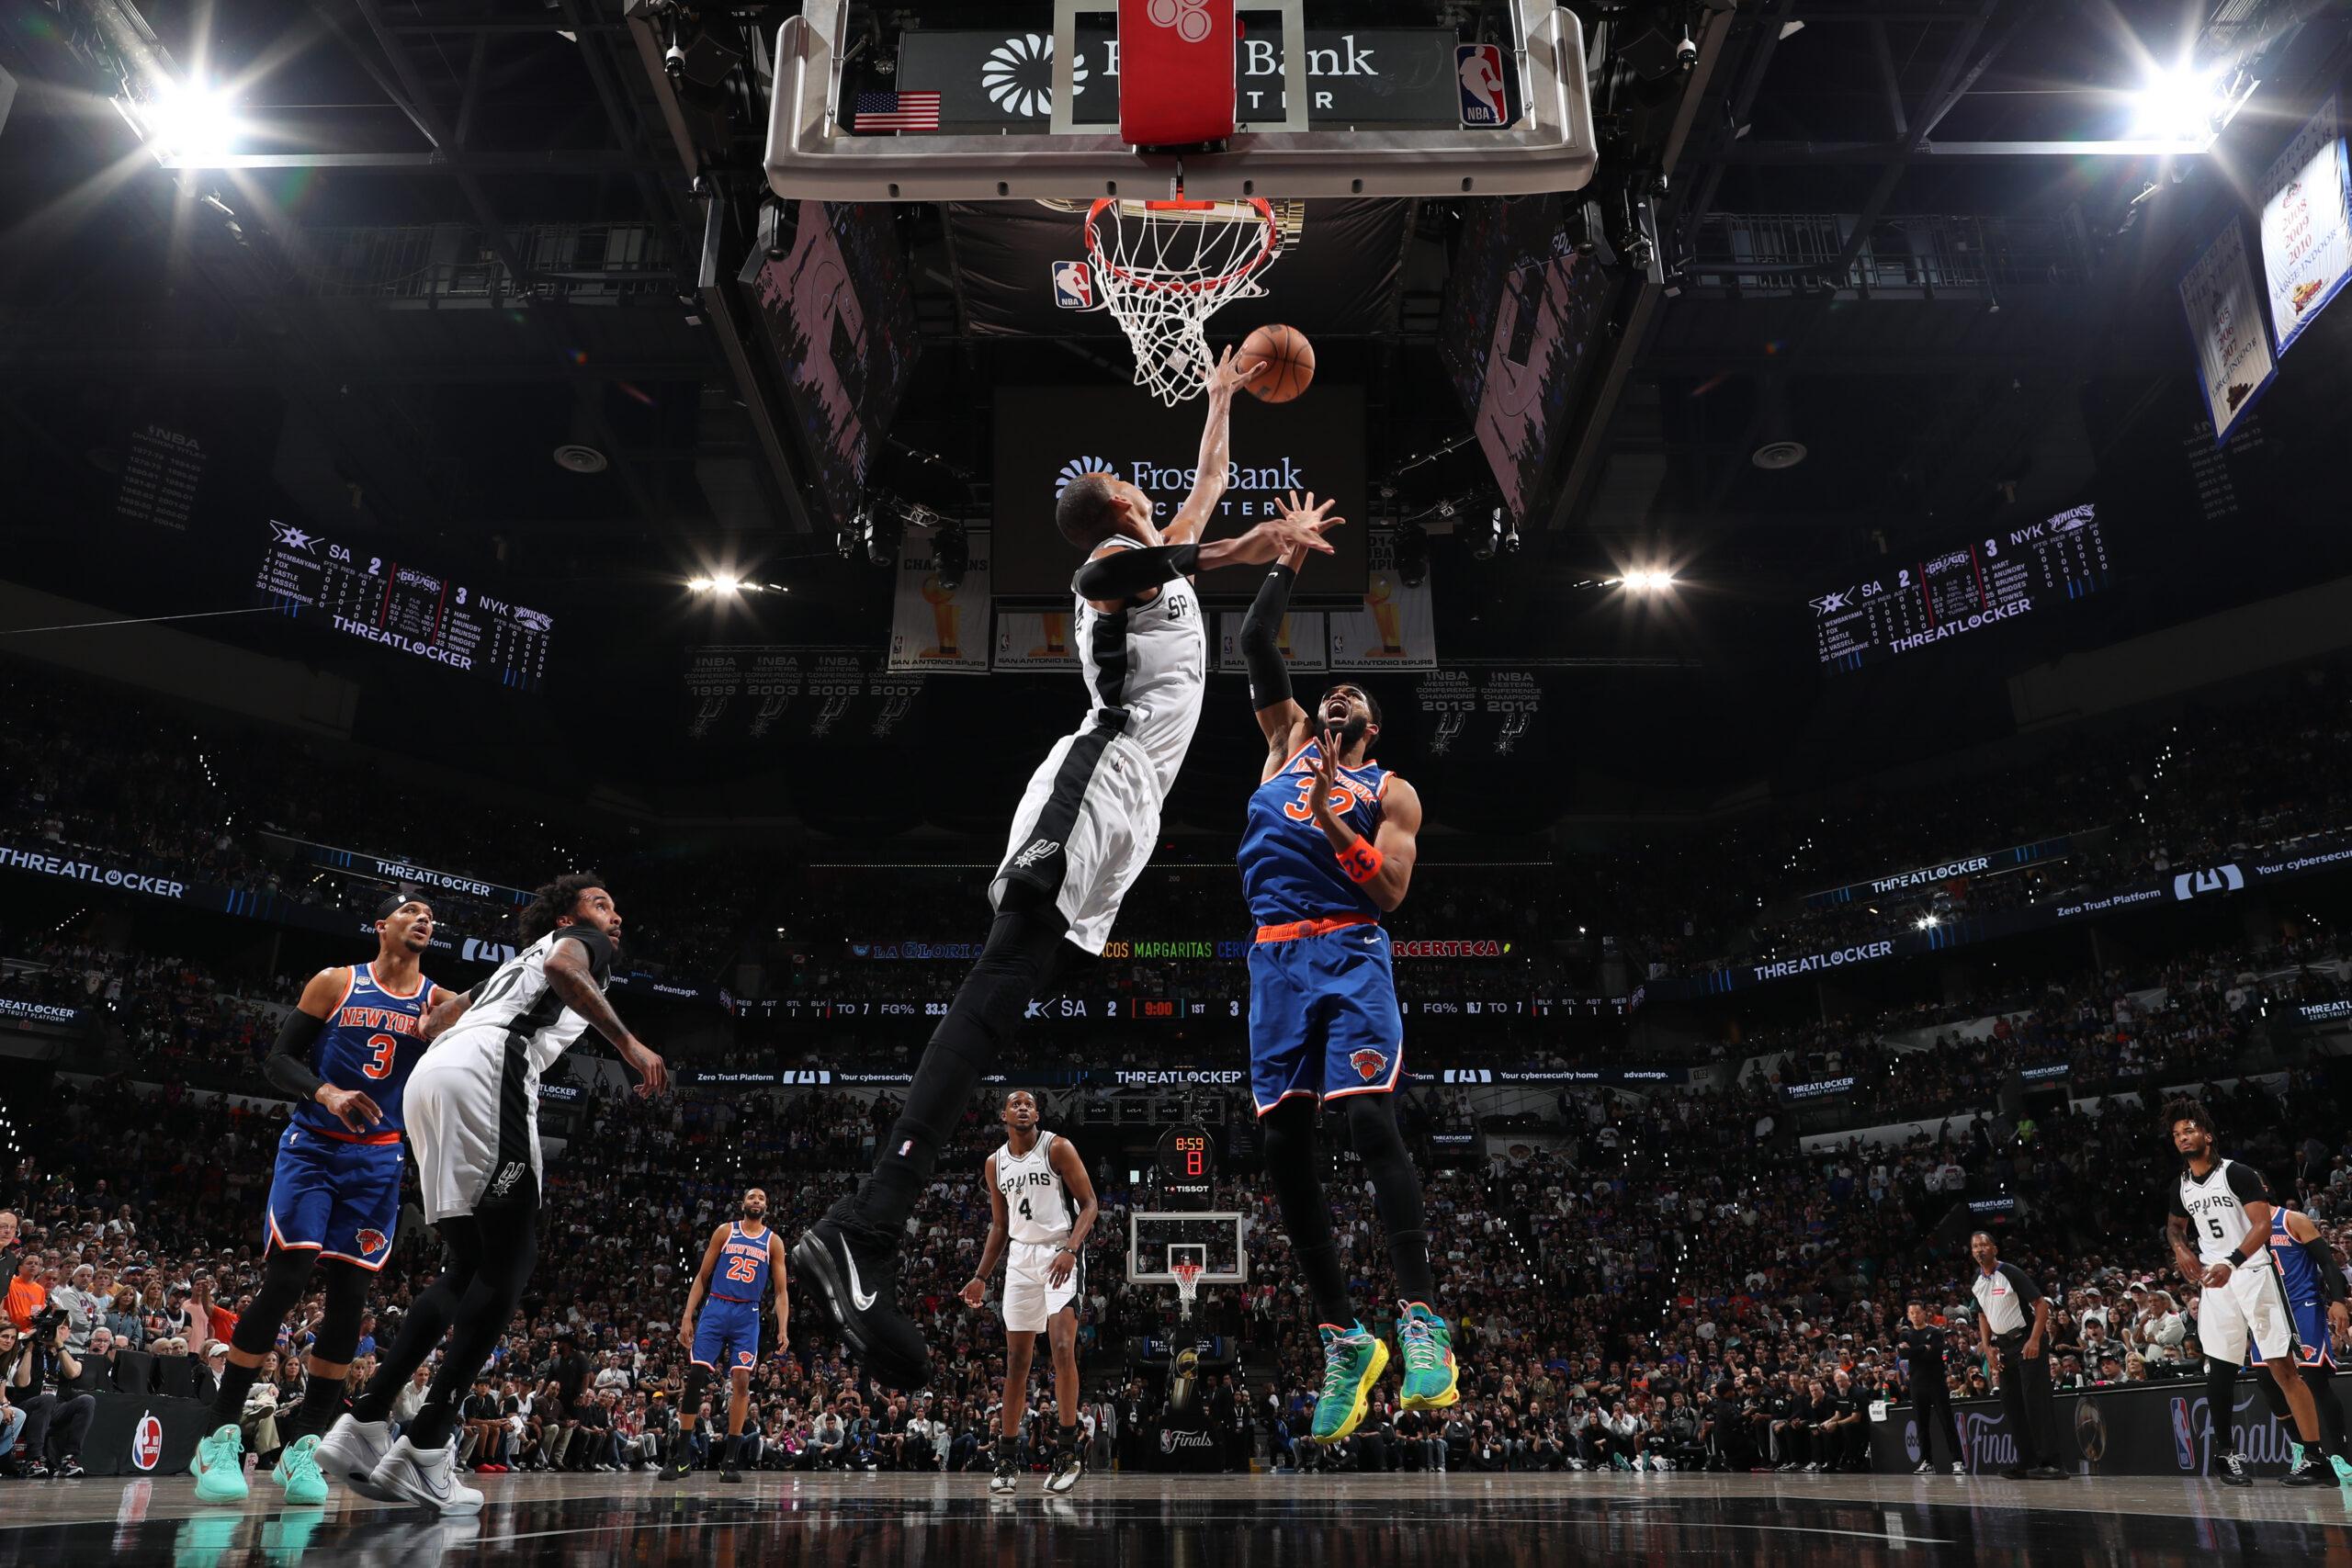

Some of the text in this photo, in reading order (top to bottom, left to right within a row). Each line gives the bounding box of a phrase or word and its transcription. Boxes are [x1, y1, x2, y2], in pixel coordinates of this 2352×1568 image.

[1245, 35, 1378, 75] Bnk
[1467, 107, 1489, 120] NBA
[2285, 216, 2310, 249] 2009
[2288, 234, 2312, 266] 2010
[1061, 298, 1079, 306] NBA
[1131, 461, 1194, 491] Fros
[1861, 503, 2095, 597] SA 2 3 NYK KNICKS
[275, 559, 289, 570] FOX
[277, 551, 322, 570] WEMBANYAMA
[904, 558, 988, 572] CHANS
[1992, 559, 2009, 570] HART
[272, 568, 300, 581] CASTLE
[1994, 563, 2026, 579] ANUNOBY
[270, 577, 300, 592] VASSELL
[329, 544, 550, 628] SA 2 3 NYK KNICKS
[1996, 571, 2029, 587] BRUNSON
[268, 585, 314, 604] CHAMPAGNIE
[1997, 581, 2027, 595] BRIDGES
[1998, 591, 2024, 604] TOWNS
[454, 610, 471, 621] HART
[1825, 610, 1863, 628] WEMBANYAMA
[452, 619, 481, 633] ANUNOBY
[1826, 626, 1838, 636] FOX
[1890, 598, 2032, 653] THREATLOCKER
[450, 626, 481, 641] BRUNSON
[1827, 631, 1850, 643] CASTLE
[332, 615, 472, 671] THREATLOCKER
[447, 642, 470, 655] TOWNS
[448, 635, 476, 649] BRIDGES
[1828, 638, 1855, 651] VASSELL
[1830, 641, 1871, 660] CHAMPAGNIE
[702, 657, 736, 667] NBA
[763, 657, 798, 666] NBA
[825, 657, 860, 666] NBA
[1401, 659, 1434, 667] SPURS
[1432, 671, 1470, 681] NBA
[1498, 671, 1534, 682] NBA
[691, 685, 736, 696] 1999
[748, 685, 798, 695] 2003
[809, 685, 860, 695] 2005
[871, 685, 922, 696] 2007
[1422, 701, 1476, 711] 2013
[1487, 701, 1539, 712] 2014
[1283, 777, 1357, 833] 32
[0, 847, 184, 898] THREATLOCKER
[375, 861, 491, 897] THREATLOCKER
[1871, 857, 1989, 894] THREATLOCKER
[2057, 906, 2082, 917] Zero
[2083, 897, 2111, 911] Trust
[2113, 887, 2161, 906] Platform
[2256, 862, 2284, 875] Your
[359, 923, 377, 935] Zer
[1135, 942, 1213, 958] MARGARITAS
[1391, 940, 1499, 957] RGERTECA
[1753, 941, 1894, 981] THREATLOCKER
[610, 975, 628, 985] ome
[652, 983, 699, 998] advantage.
[837, 1003, 948, 1016] TO 7 FG% 33.3
[1060, 999, 1239, 1017] SA 2 9:00 1ST 3
[1423, 1001, 1522, 1014] FG% 16.7 TO 7
[7, 1009, 65, 1022] TRUST PLATFORM
[338, 1007, 383, 1029] NEW
[2310, 1010, 2350, 1021] ZERO TRUST
[363, 1033, 397, 1080] 3
[697, 1072, 914, 1084] Zero Trust Platform Your cybersecurity
[1115, 1070, 1242, 1084] THREATLOCKER
[1500, 1070, 1668, 1082] Your cybersecurity home advantage.
[1787, 1077, 1854, 1094] THREATLOCKER
[1176, 1137, 1204, 1151] 8:59
[1187, 1151, 1202, 1176] 8
[1000, 1173, 1051, 1196] SPURS
[1019, 1198, 1033, 1221] 4
[2188, 1195, 2234, 1215] SPURS
[2208, 1219, 2223, 1239] 5
[726, 1244, 767, 1263] NEW YORK
[727, 1256, 759, 1283] 25
[1169, 1429, 1214, 1454] Finals
[2191, 1393, 2294, 1477] Fnals
[1967, 1412, 2018, 1475] Fina
